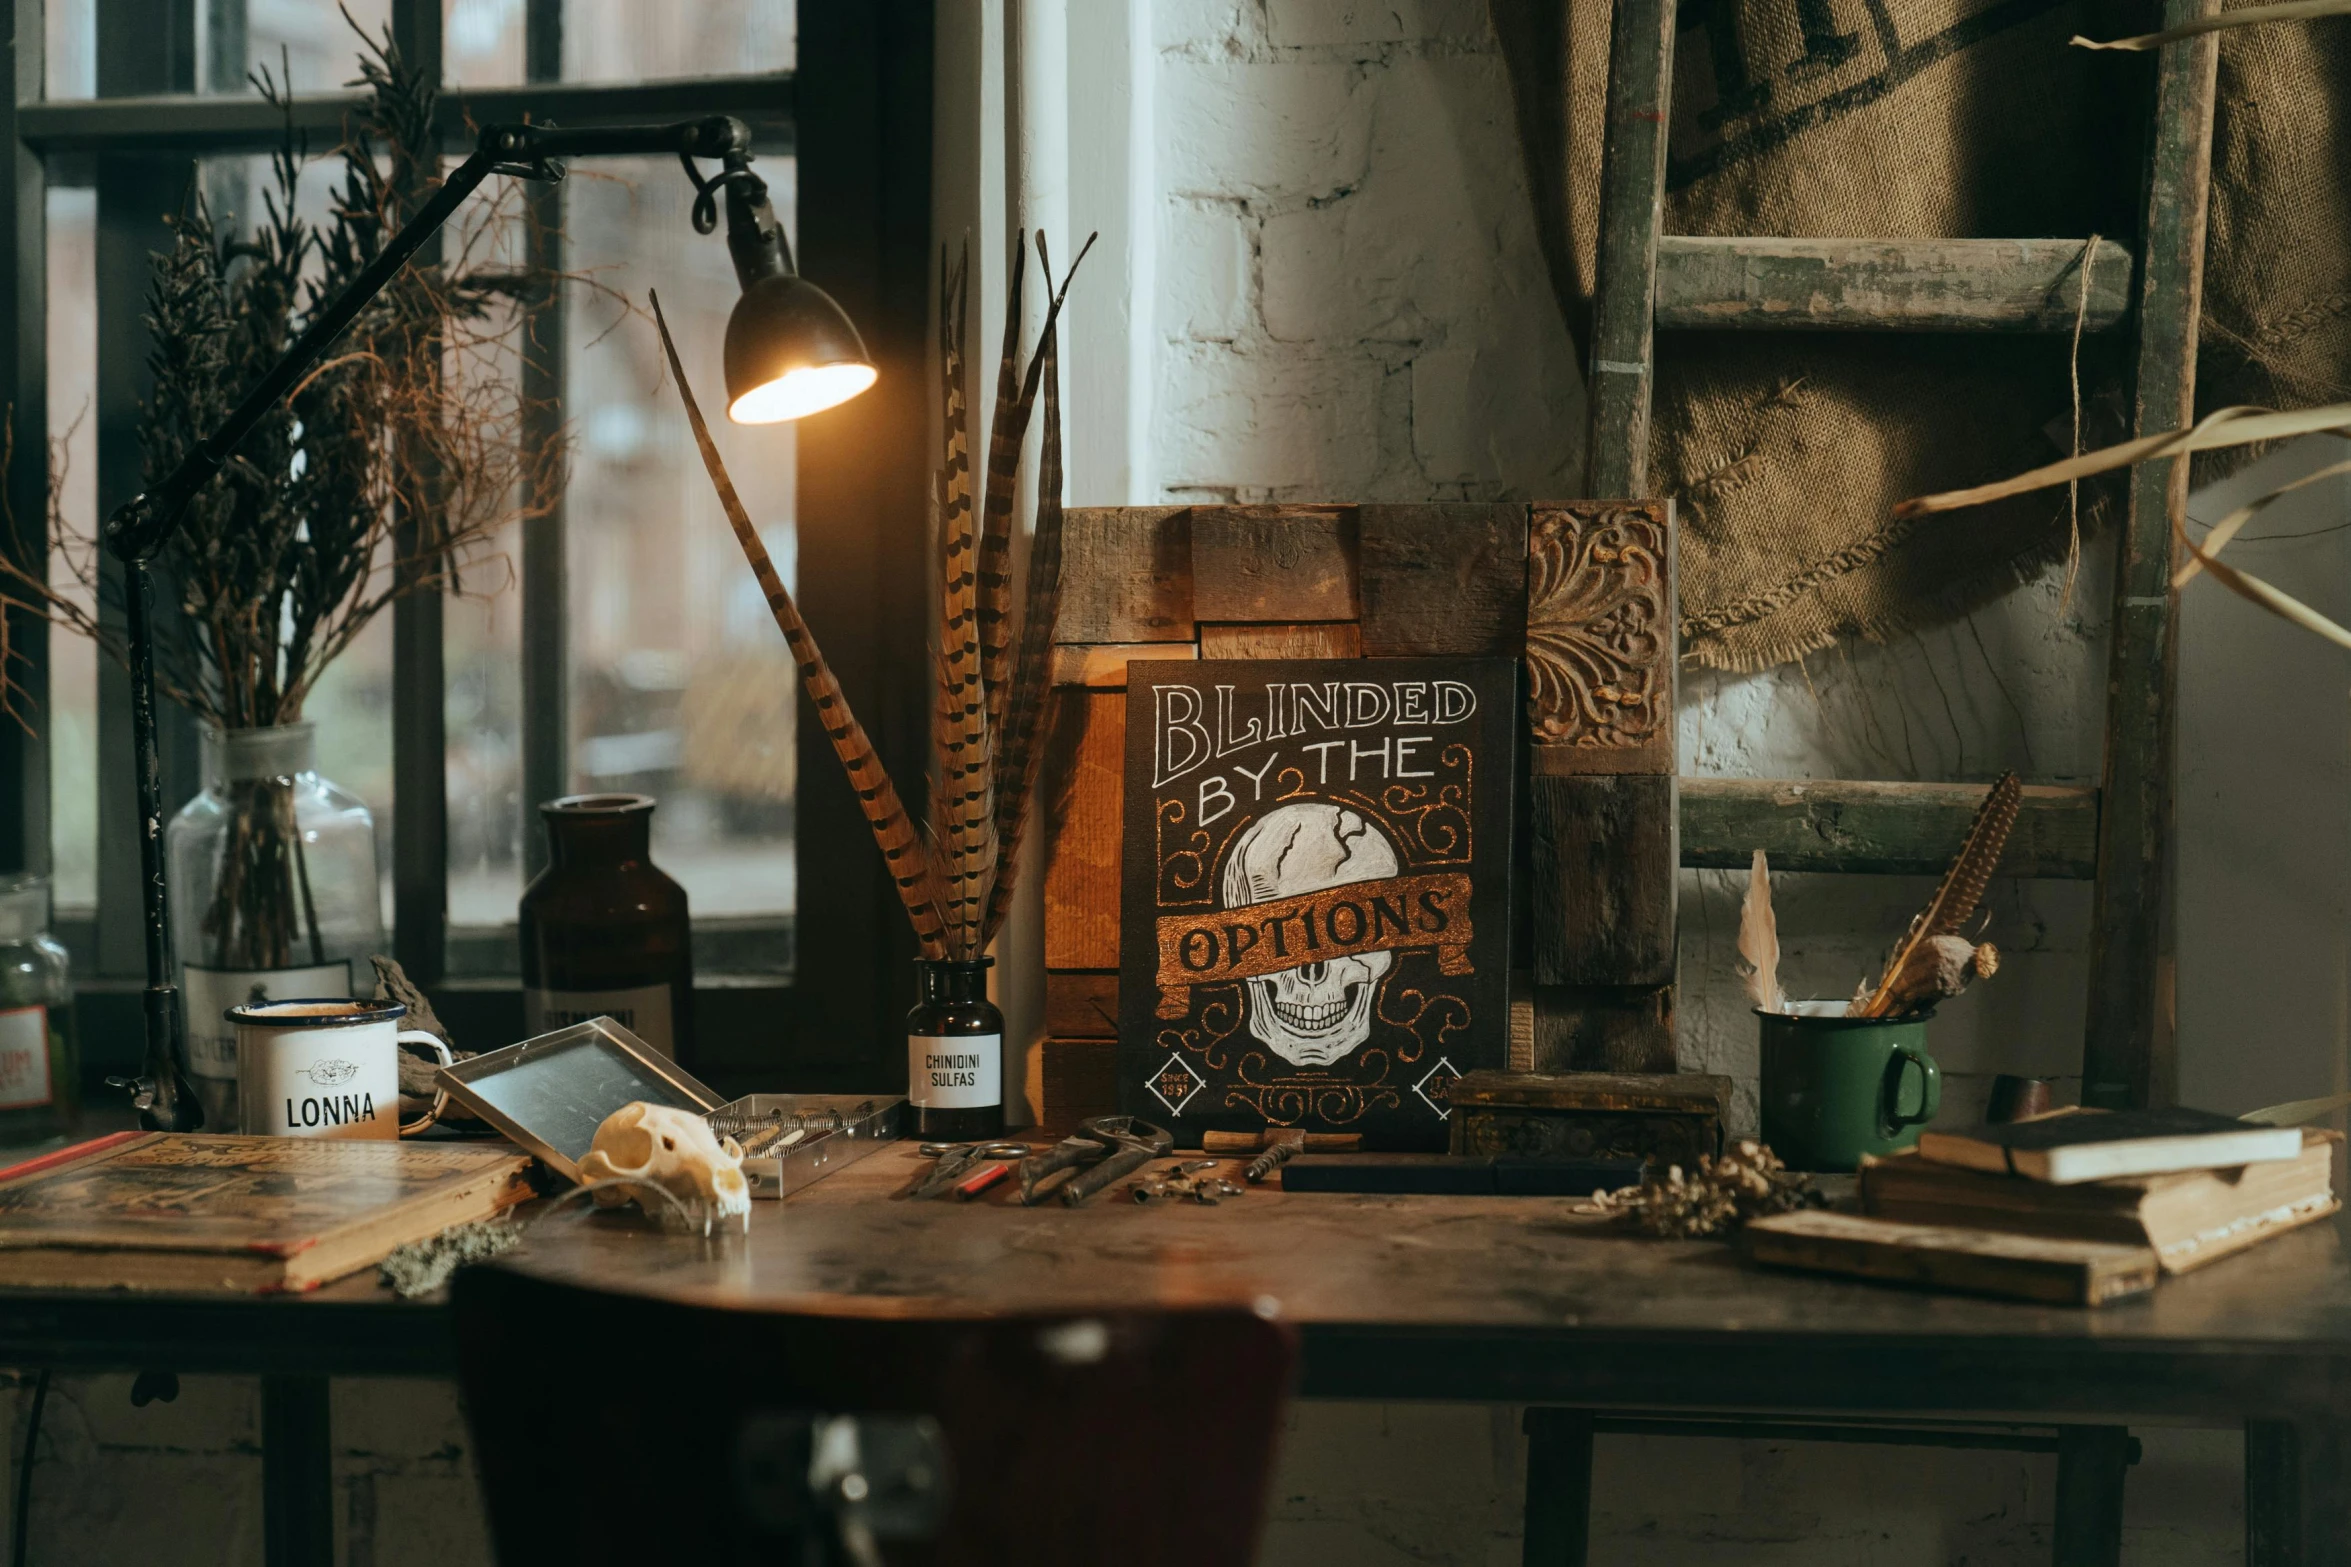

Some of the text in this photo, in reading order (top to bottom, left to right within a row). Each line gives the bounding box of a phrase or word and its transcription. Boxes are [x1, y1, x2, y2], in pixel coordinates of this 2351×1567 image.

[1151, 681, 1477, 789] BLINDED
[1198, 736, 1436, 827] BY THE
[1179, 890, 1454, 973] OPTIONS
[925, 1053, 980, 1069] CHINIDINI
[1160, 1072, 1190, 1083] SINCE
[931, 1072, 975, 1087] SULFAS
[286, 1092, 376, 1128] LONNA
